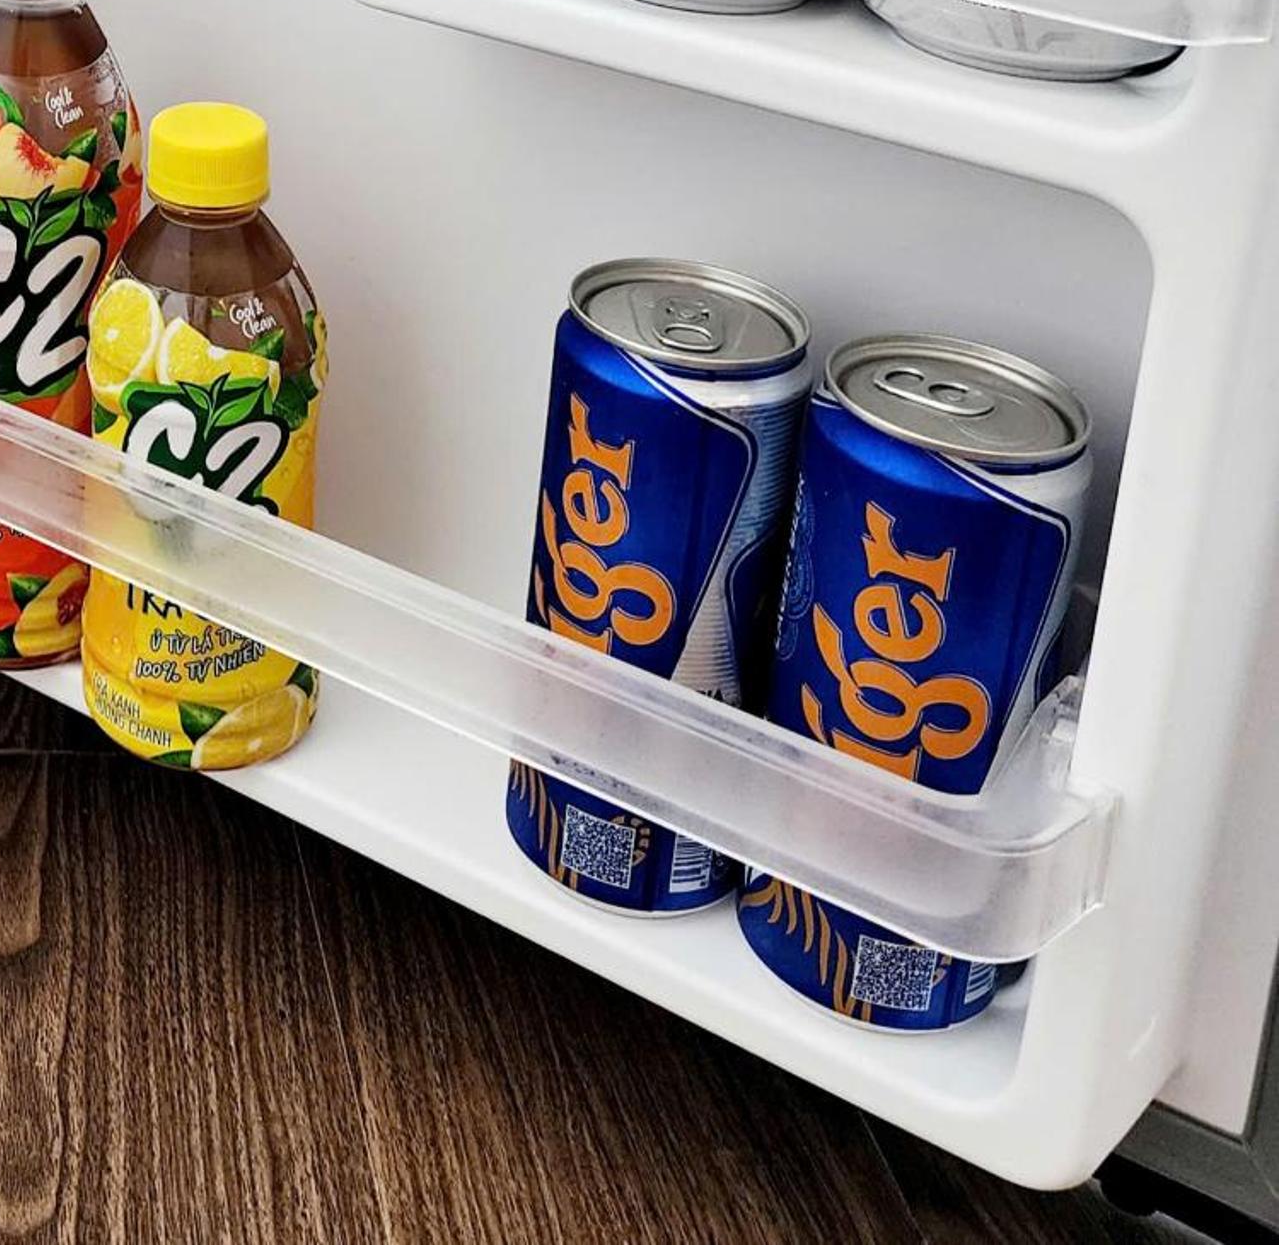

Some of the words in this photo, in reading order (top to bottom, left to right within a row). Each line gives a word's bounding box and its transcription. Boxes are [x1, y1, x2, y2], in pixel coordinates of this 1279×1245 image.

[242, 314, 277, 340] Clean
[125, 399, 283, 518] C2
[135, 658, 182, 682] 100%
[128, 718, 172, 748] CHANH
